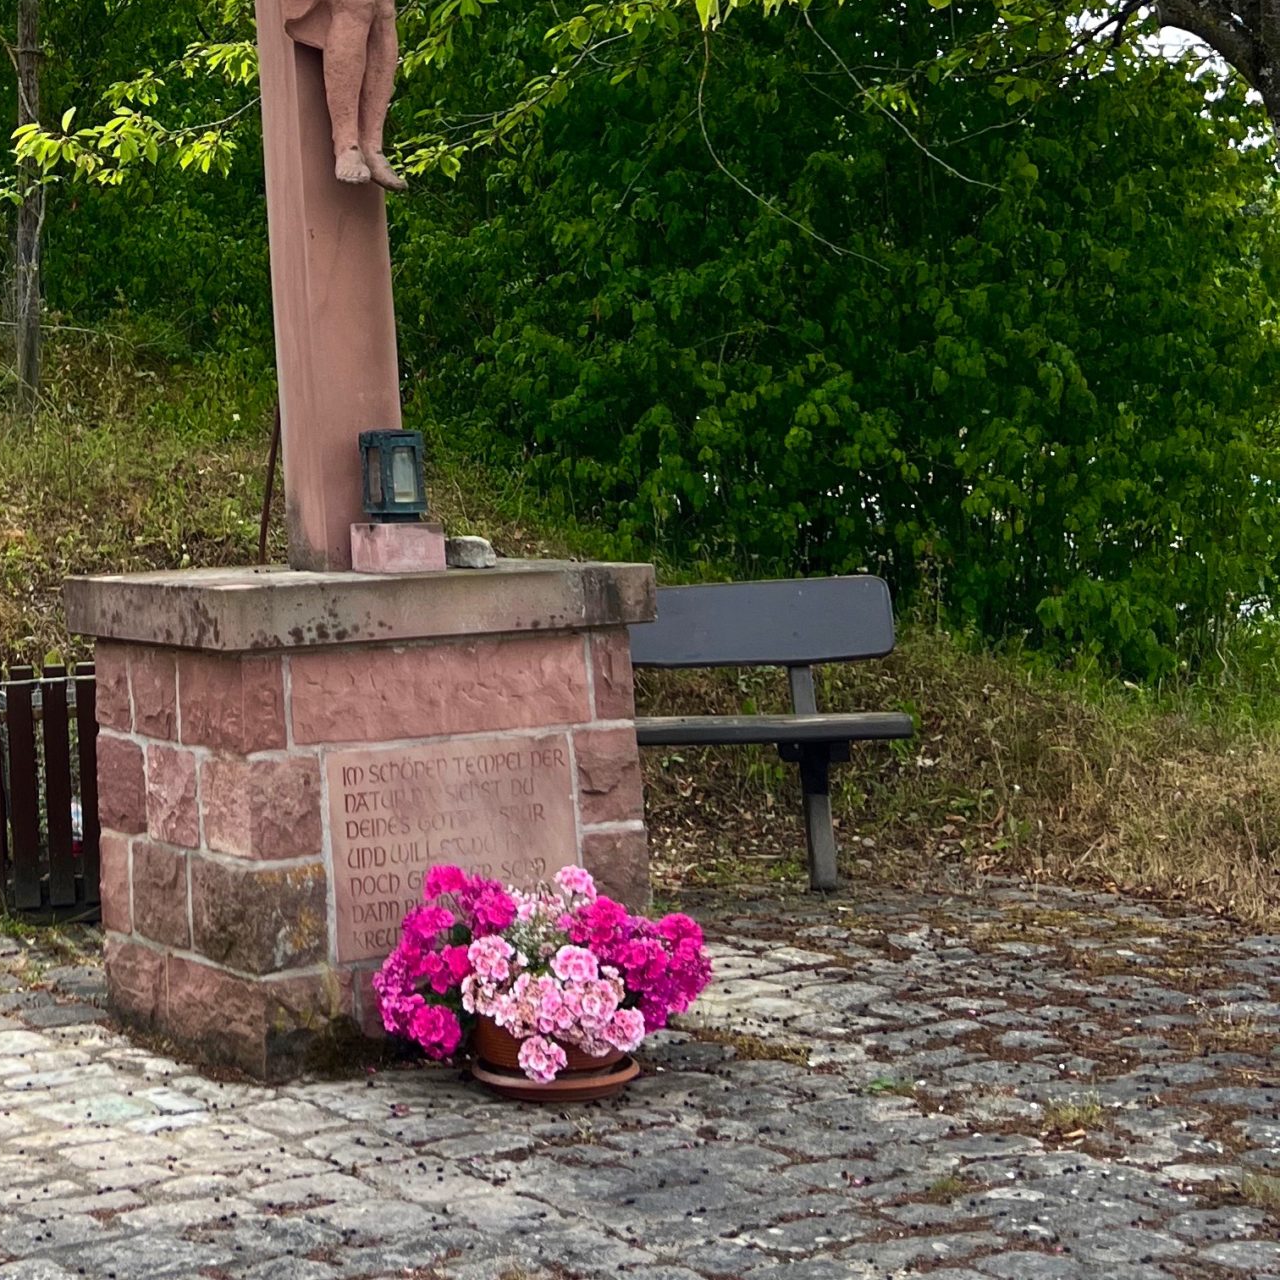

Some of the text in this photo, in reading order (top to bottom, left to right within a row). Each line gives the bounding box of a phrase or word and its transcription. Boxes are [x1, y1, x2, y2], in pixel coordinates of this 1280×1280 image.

[342, 748, 566, 787] IM SCHÖNEN TEMPEL DER
[344, 789, 406, 814] NATUR
[510, 777, 535, 797] DU
[345, 816, 411, 839] DEINES
[347, 846, 386, 869] UND
[351, 872, 400, 897] NOCH
[352, 900, 400, 923] DANN
